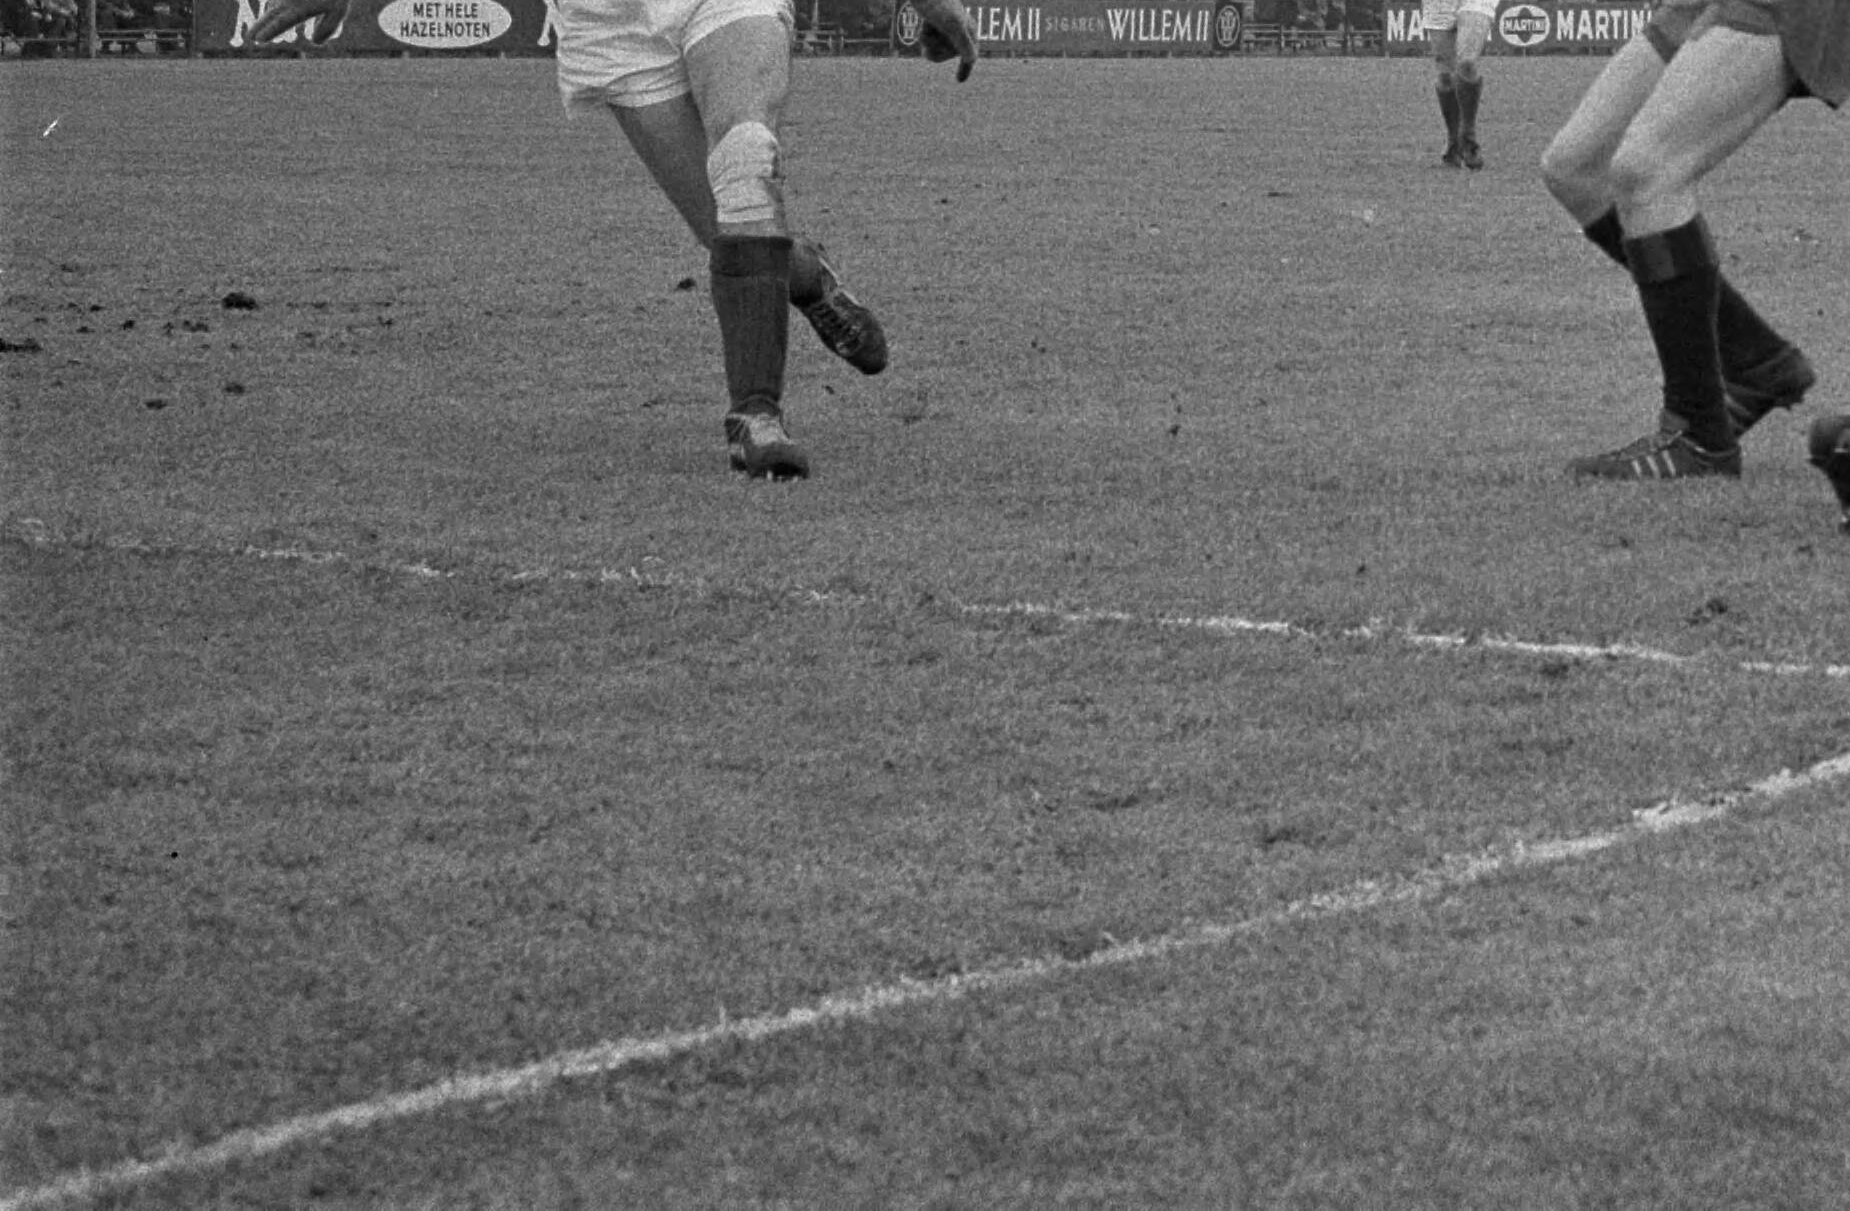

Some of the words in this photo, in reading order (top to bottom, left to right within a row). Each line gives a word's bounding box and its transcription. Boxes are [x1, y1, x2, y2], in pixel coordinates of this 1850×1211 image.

[413, 2, 440, 18] MET
[445, 2, 478, 19] HELE
[401, 21, 490, 38] HAZELNOTEN
[1106, 9, 1191, 41] WILLEM
[1196, 10, 1210, 41] II
[1505, 19, 1545, 31] MARTINI
